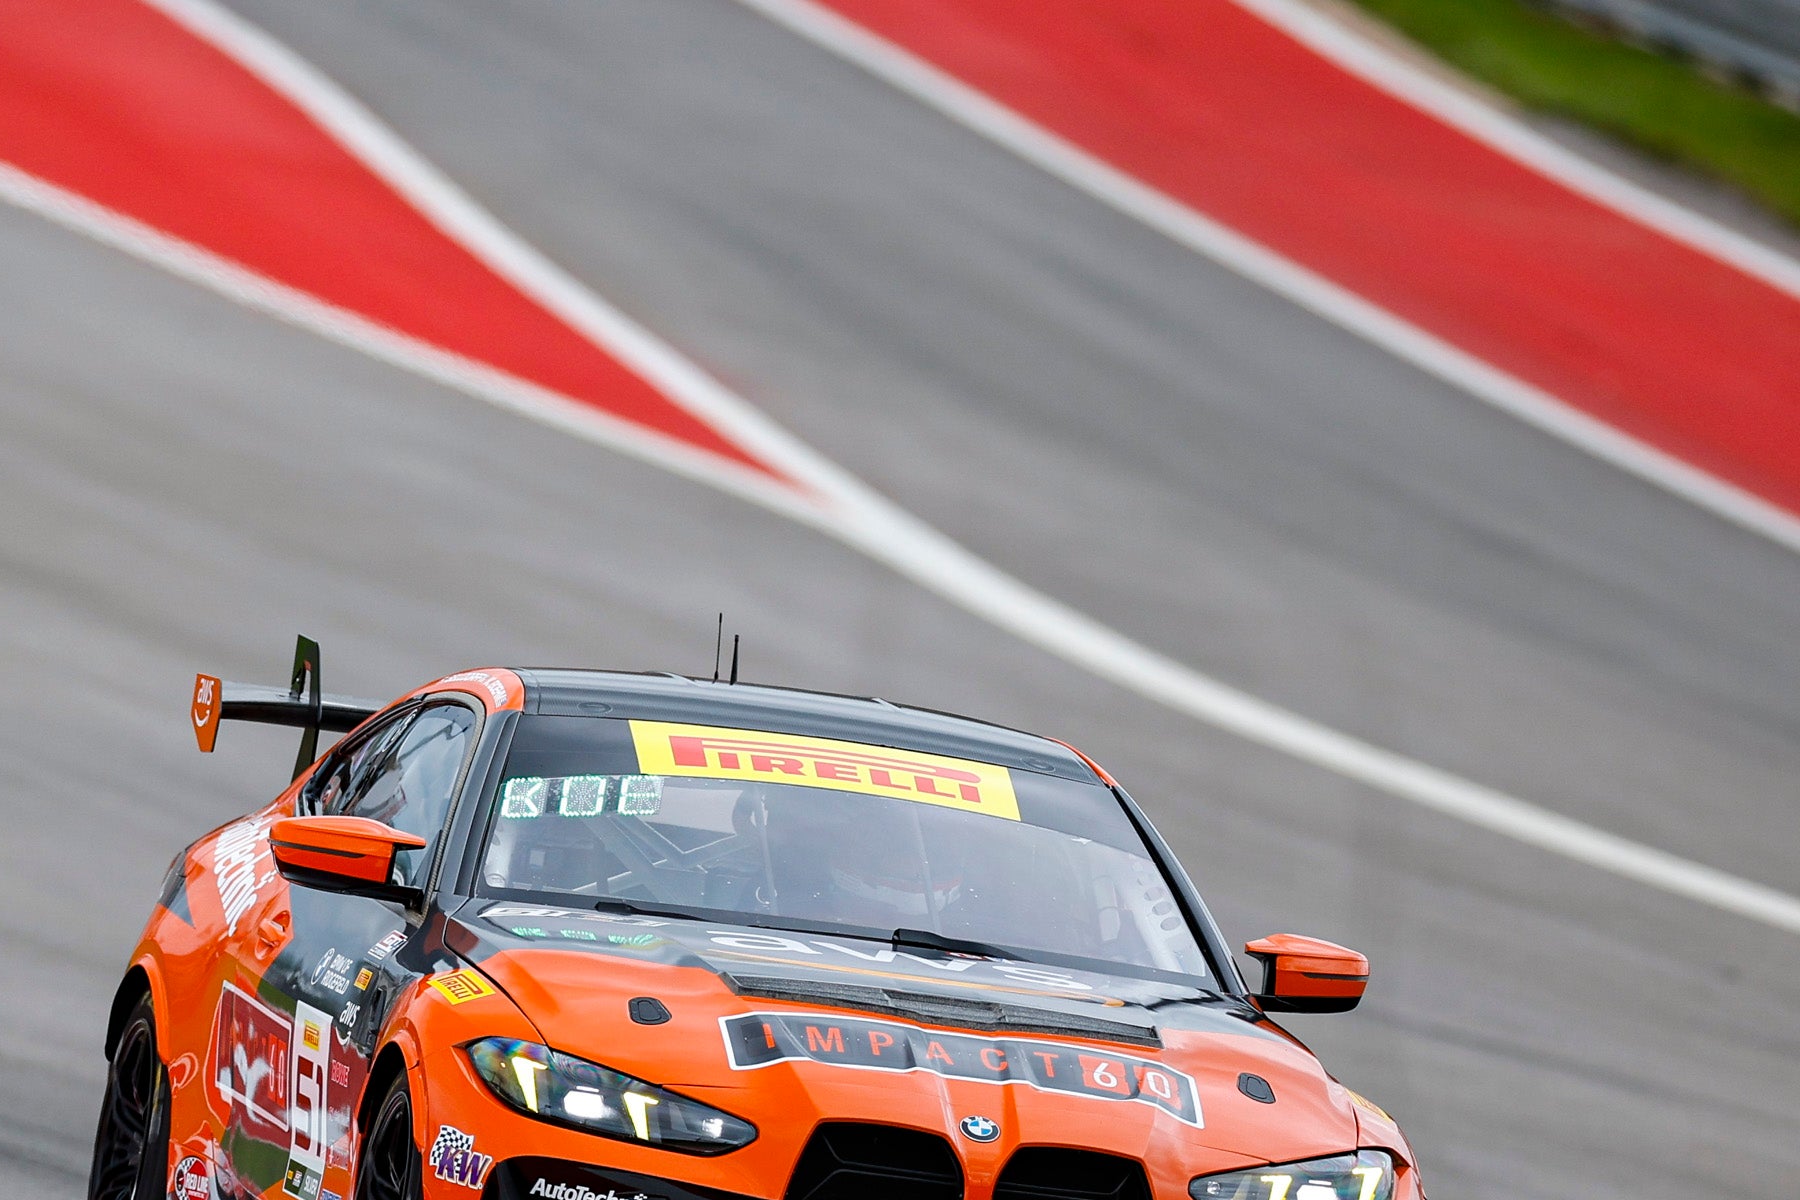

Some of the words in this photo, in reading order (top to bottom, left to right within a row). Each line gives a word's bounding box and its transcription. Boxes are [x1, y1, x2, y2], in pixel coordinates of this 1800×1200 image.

[668, 735, 982, 804] PIRELLI
[436, 973, 484, 999] PIRELLI
[706, 930, 1094, 990] aws
[339, 1001, 360, 1028] aws
[295, 1055, 323, 1158] 51
[436, 1144, 493, 1188] KW
